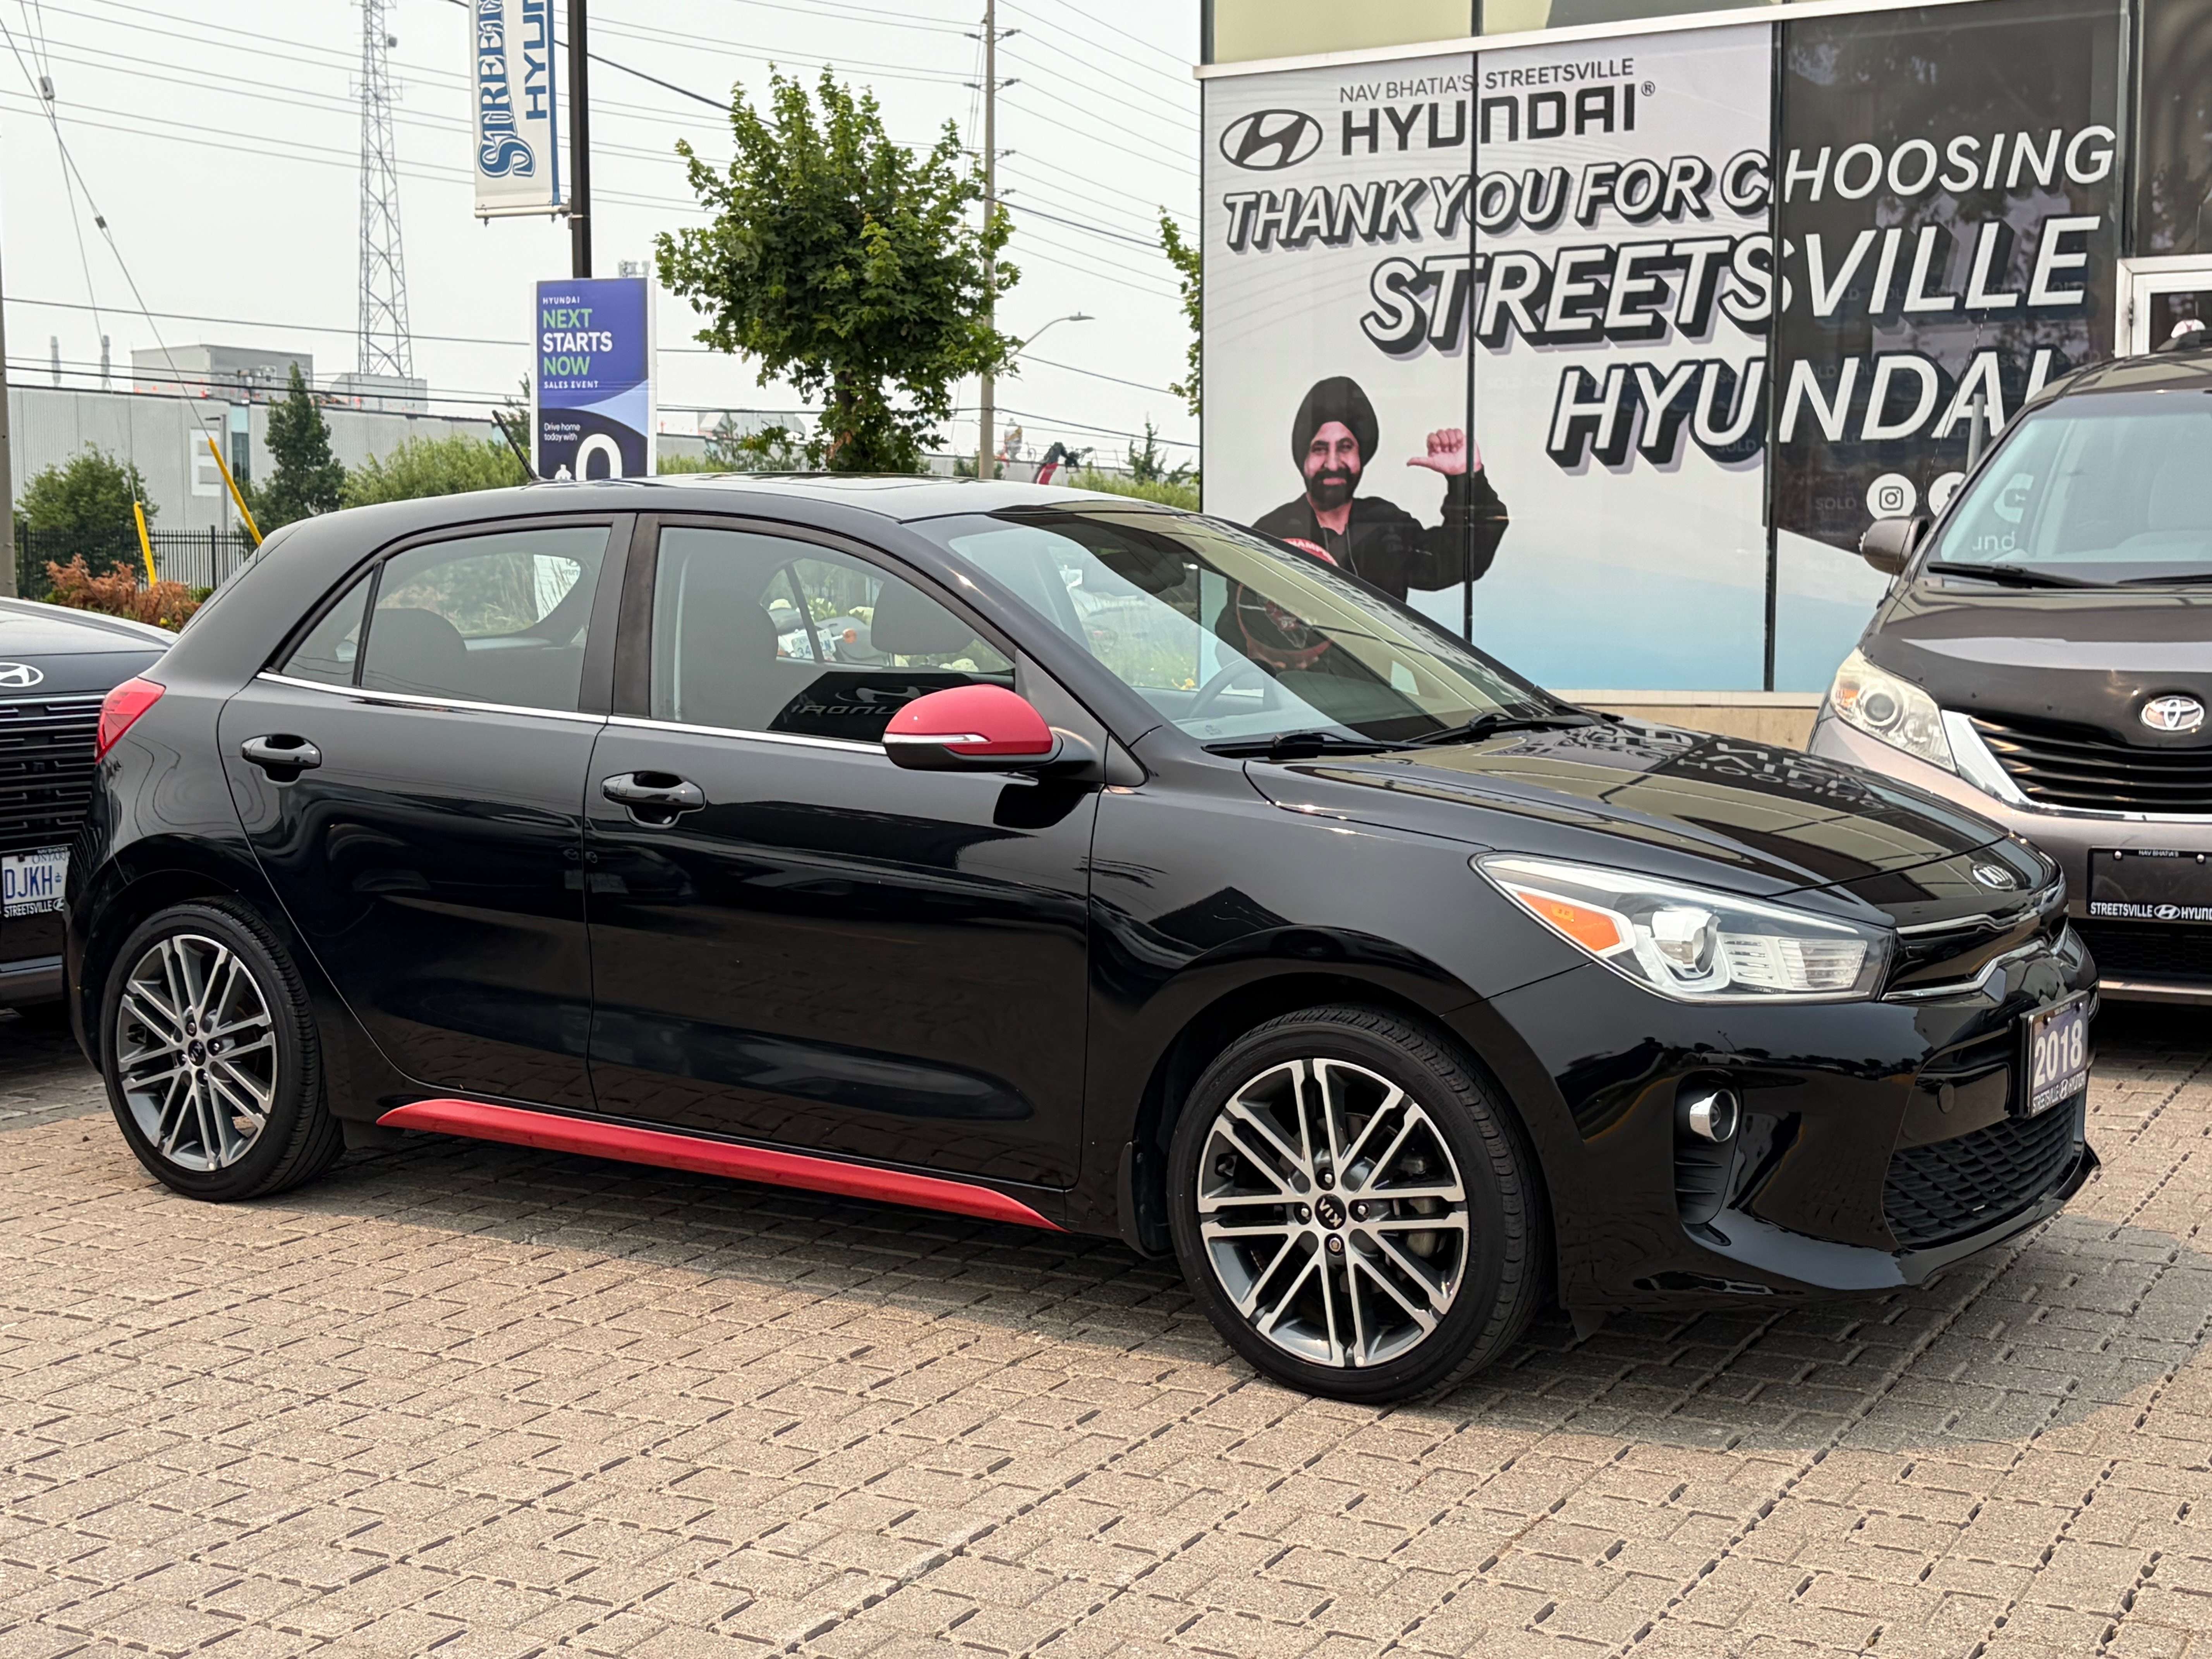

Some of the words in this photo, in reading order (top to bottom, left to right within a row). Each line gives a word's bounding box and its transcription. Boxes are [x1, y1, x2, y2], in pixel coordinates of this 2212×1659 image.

[1340, 83, 1380, 103] NAV
[1386, 74, 1474, 98] BHATIA'S
[1485, 58, 1634, 89] STREETSVILLE
[1341, 84, 1635, 155] HYUNDAI
[1223, 178, 1425, 252] THANK
[1431, 166, 1568, 235] YOU
[1575, 156, 1718, 228] FOR
[1720, 125, 2116, 213] CHOOSING
[1360, 216, 2101, 353] STREETSVILLE
[543, 309, 592, 328] NEXT
[543, 331, 613, 353] STARTS
[544, 356, 590, 376] NOW
[544, 381, 568, 389] SALES
[1546, 349, 2054, 467] HYUNDAI
[544, 422, 560, 431] Drive
[561, 422, 580, 431] home
[544, 433, 562, 442] today
[563, 432, 578, 441] with
[4, 865, 53, 899] DJKH
[3, 900, 53, 917] STREETSVILLE
[2091, 902, 2153, 917] STREETSVILLE
[2033, 1019, 2083, 1088] 2018
[1319, 1197, 1343, 1228] KIA
